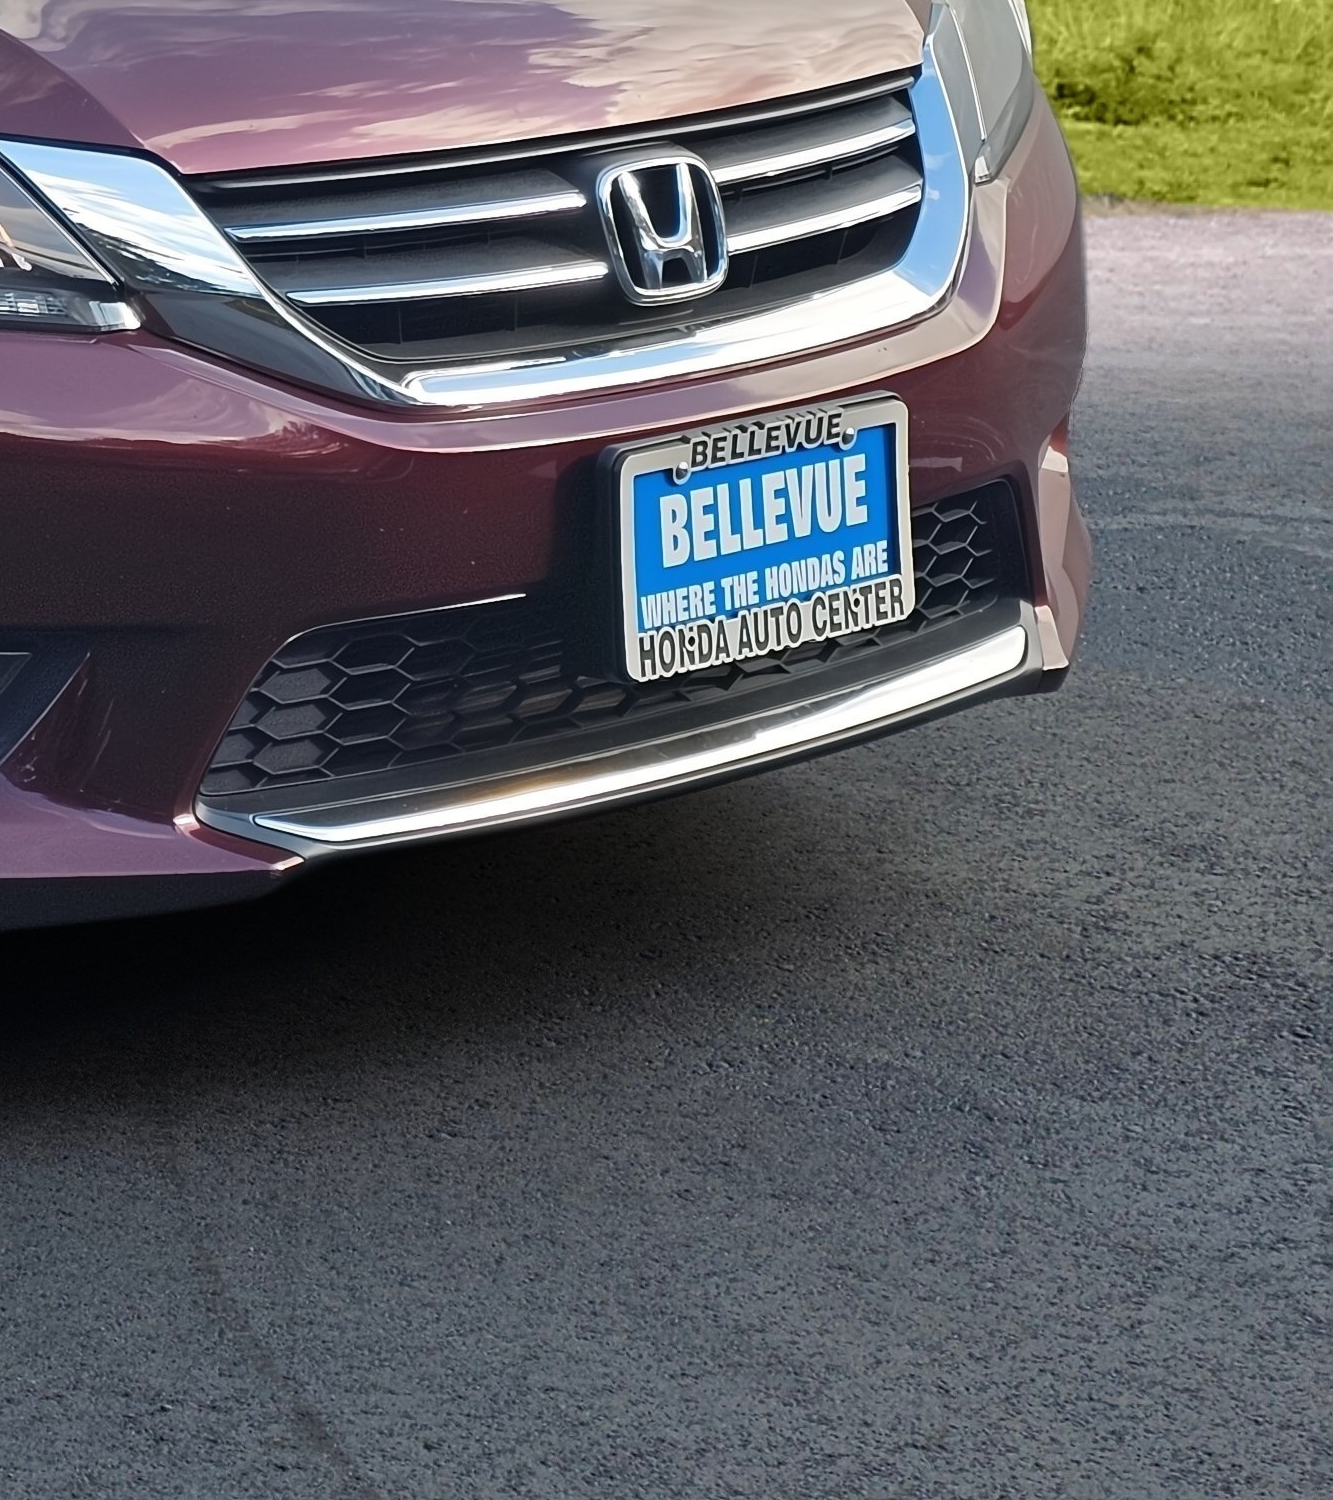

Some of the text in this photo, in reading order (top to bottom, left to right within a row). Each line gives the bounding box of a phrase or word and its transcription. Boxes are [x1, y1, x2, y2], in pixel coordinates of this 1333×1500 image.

[690, 412, 843, 469] BELLEVUE
[659, 453, 869, 568] BELLEVUE
[637, 578, 905, 679] HONDA AUTO CENTER
[640, 540, 889, 630] WHERE THE HONDAS ARE
